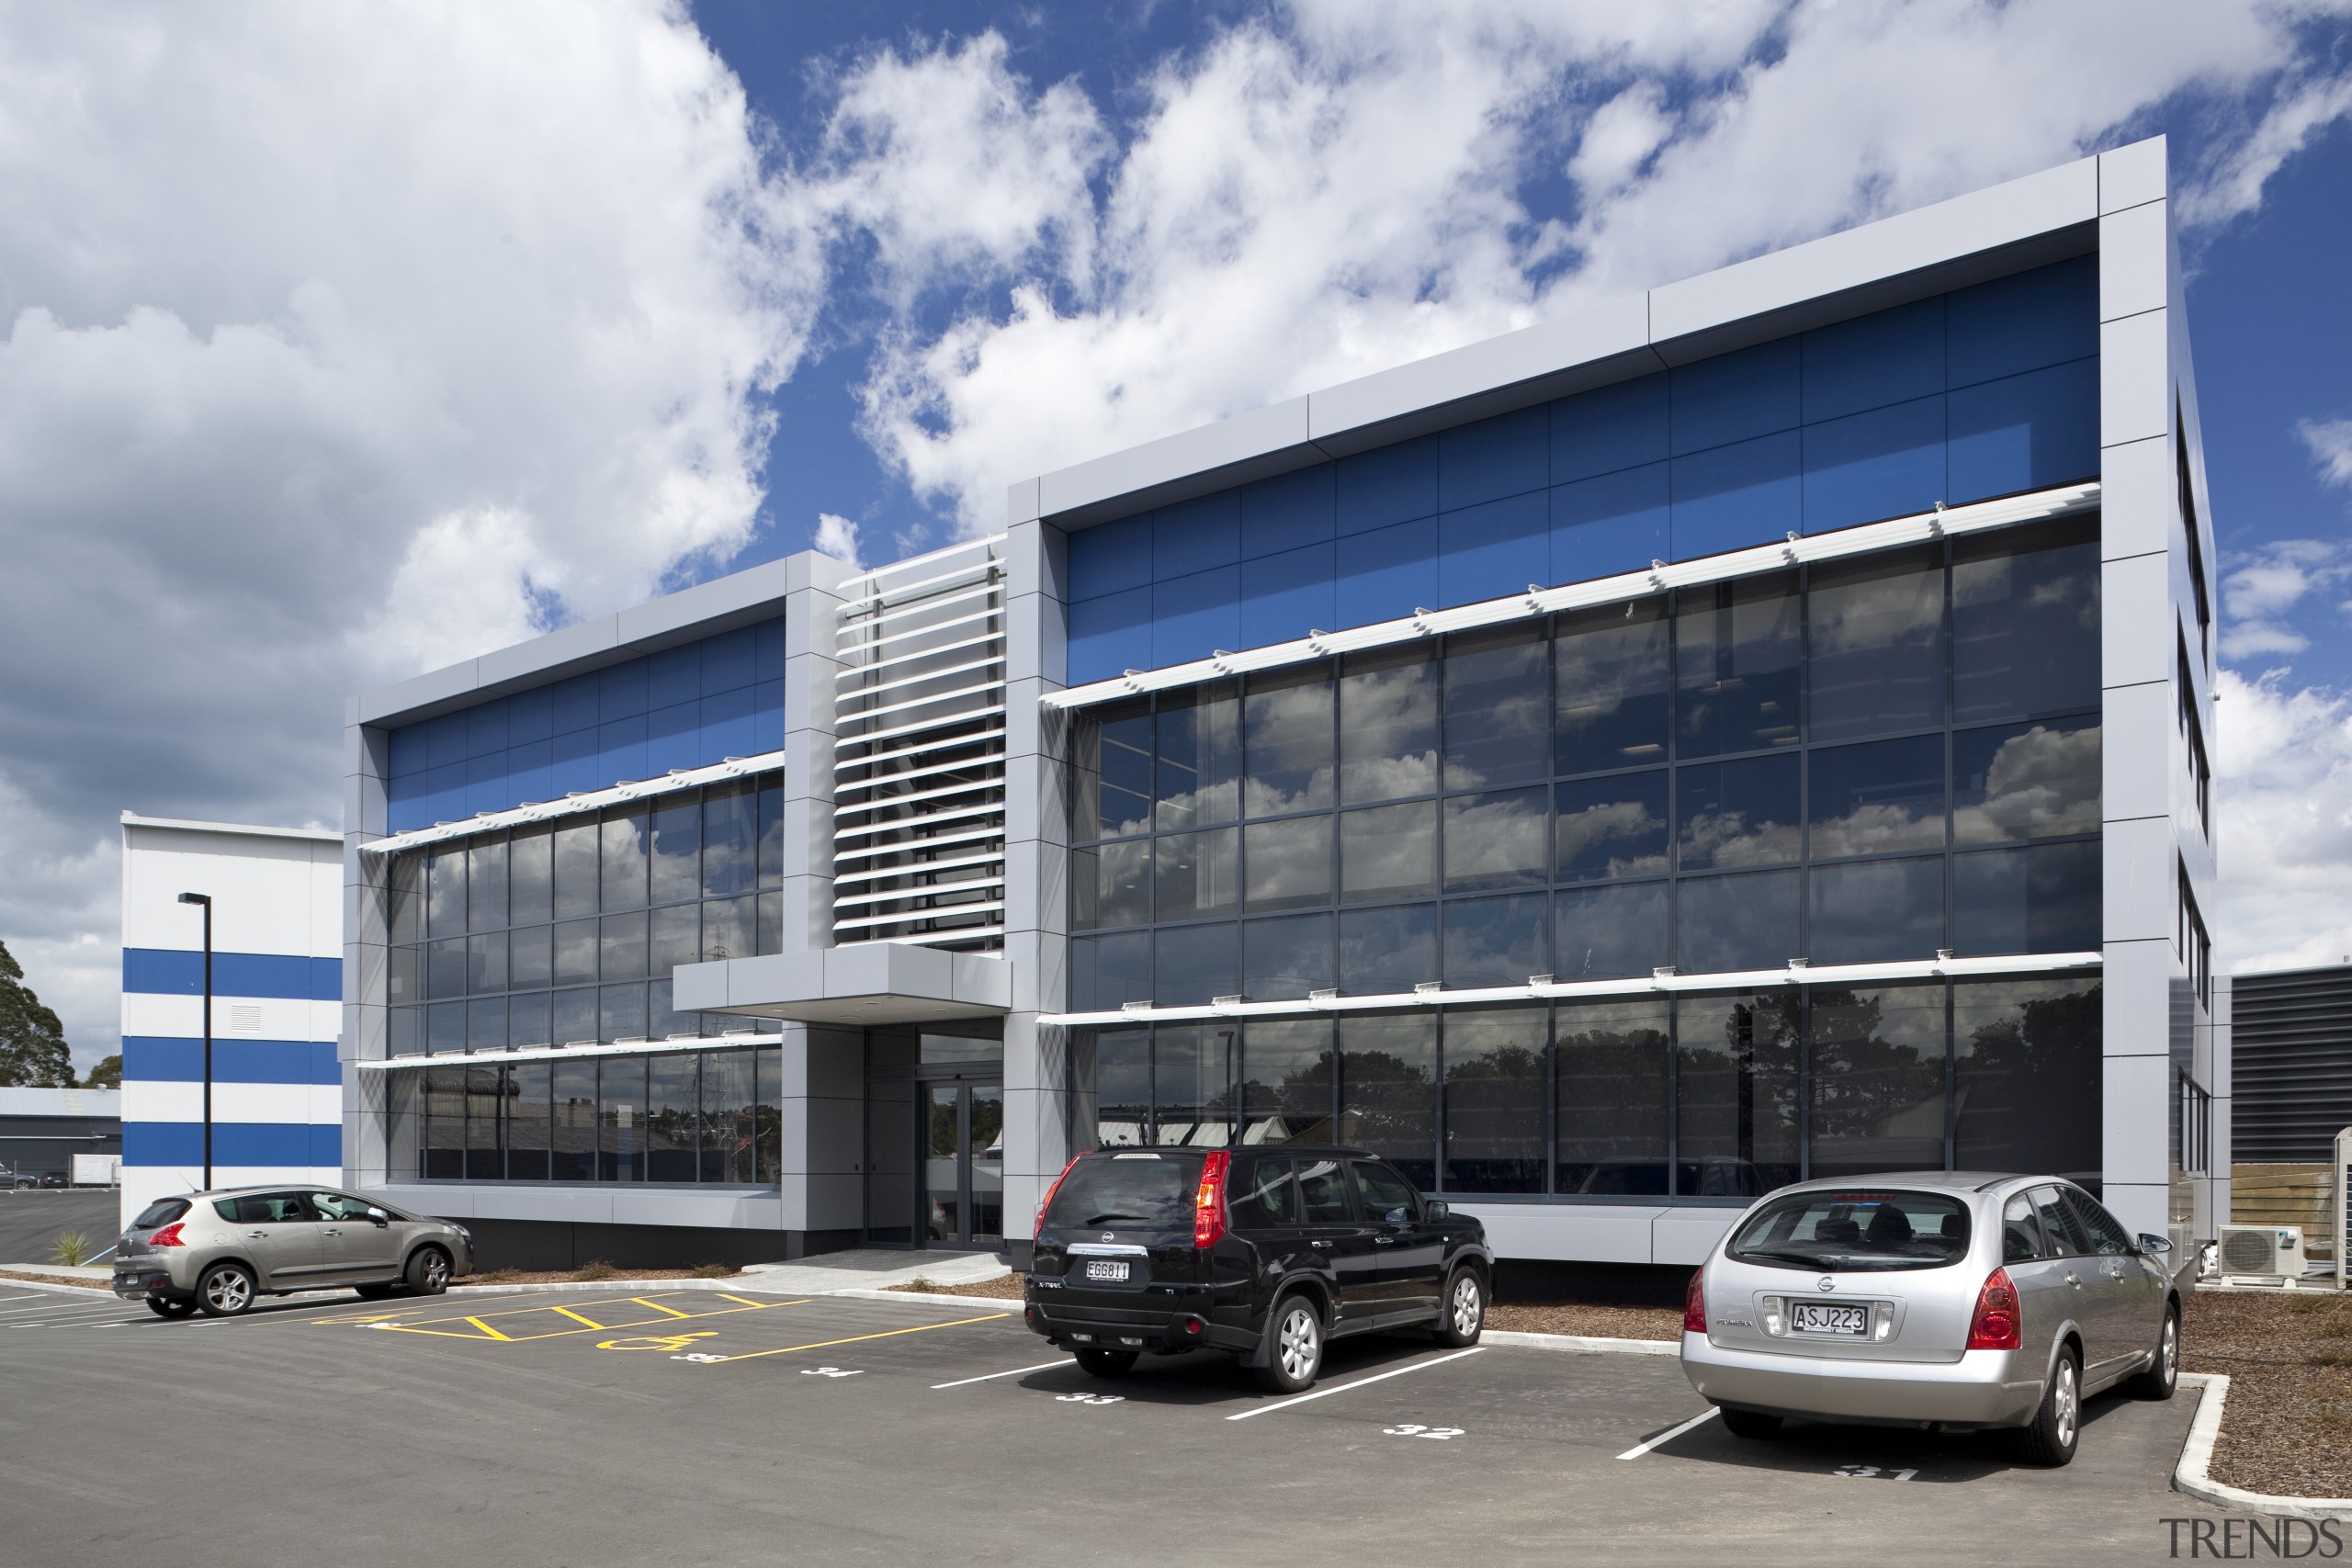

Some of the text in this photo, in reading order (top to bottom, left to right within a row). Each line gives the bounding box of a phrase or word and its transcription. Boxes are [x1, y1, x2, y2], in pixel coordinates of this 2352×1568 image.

[1088, 1263, 1126, 1278] EGG811
[1716, 1318, 1753, 1326] PRIMERA
[1795, 1307, 1864, 1328] ASJ223
[1383, 1424, 1465, 1440] 32
[1833, 1464, 1919, 1481] 31
